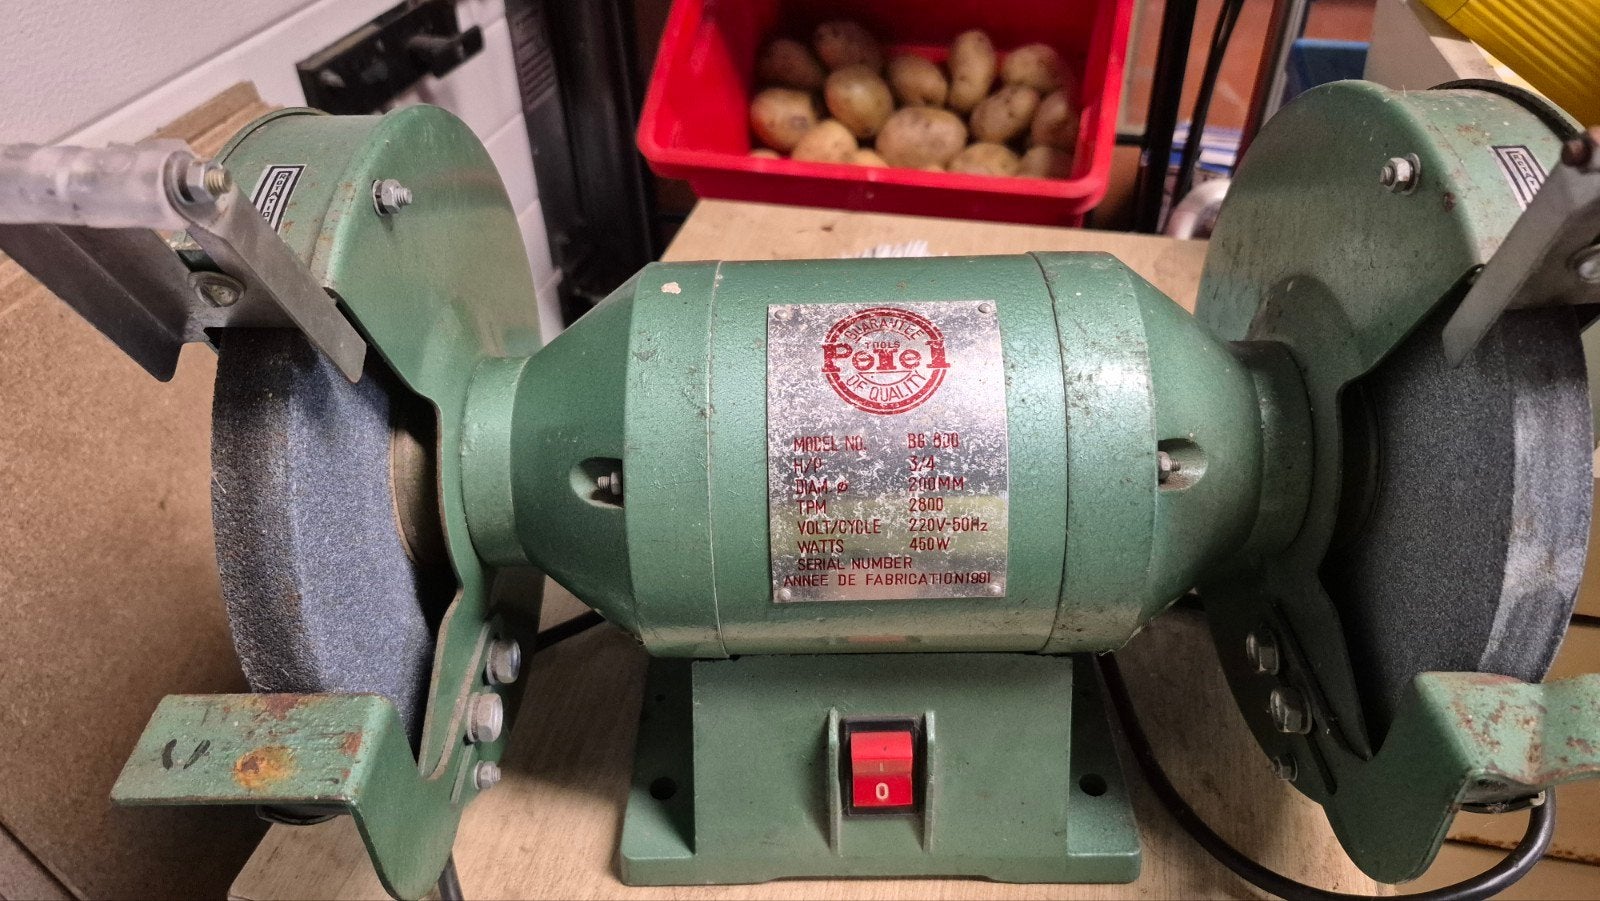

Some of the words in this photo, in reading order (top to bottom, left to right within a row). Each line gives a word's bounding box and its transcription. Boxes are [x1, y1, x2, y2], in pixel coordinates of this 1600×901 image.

[263, 173, 287, 221] ROTATIO
[843, 317, 925, 343] GUARANTEE
[865, 341, 901, 349] TOOLS
[821, 340, 951, 373] Perel
[846, 374, 866, 392] OF
[868, 370, 927, 402] QUALITY
[793, 436, 839, 452] MODEL
[908, 433, 925, 449] BG
[793, 457, 823, 473] H/P
[909, 456, 936, 472] 3/4
[796, 500, 827, 515] TPM
[909, 497, 944, 512] 2800
[797, 519, 882, 535] VOLT/CYCLE
[908, 517, 988, 532] 220V-50Hz
[797, 539, 845, 554] WATTS
[909, 537, 950, 551] 450W
[797, 558, 846, 571] SERIAL
[852, 557, 913, 570] NUMBER
[783, 574, 829, 588] ANNEE
[838, 574, 856, 586] DE
